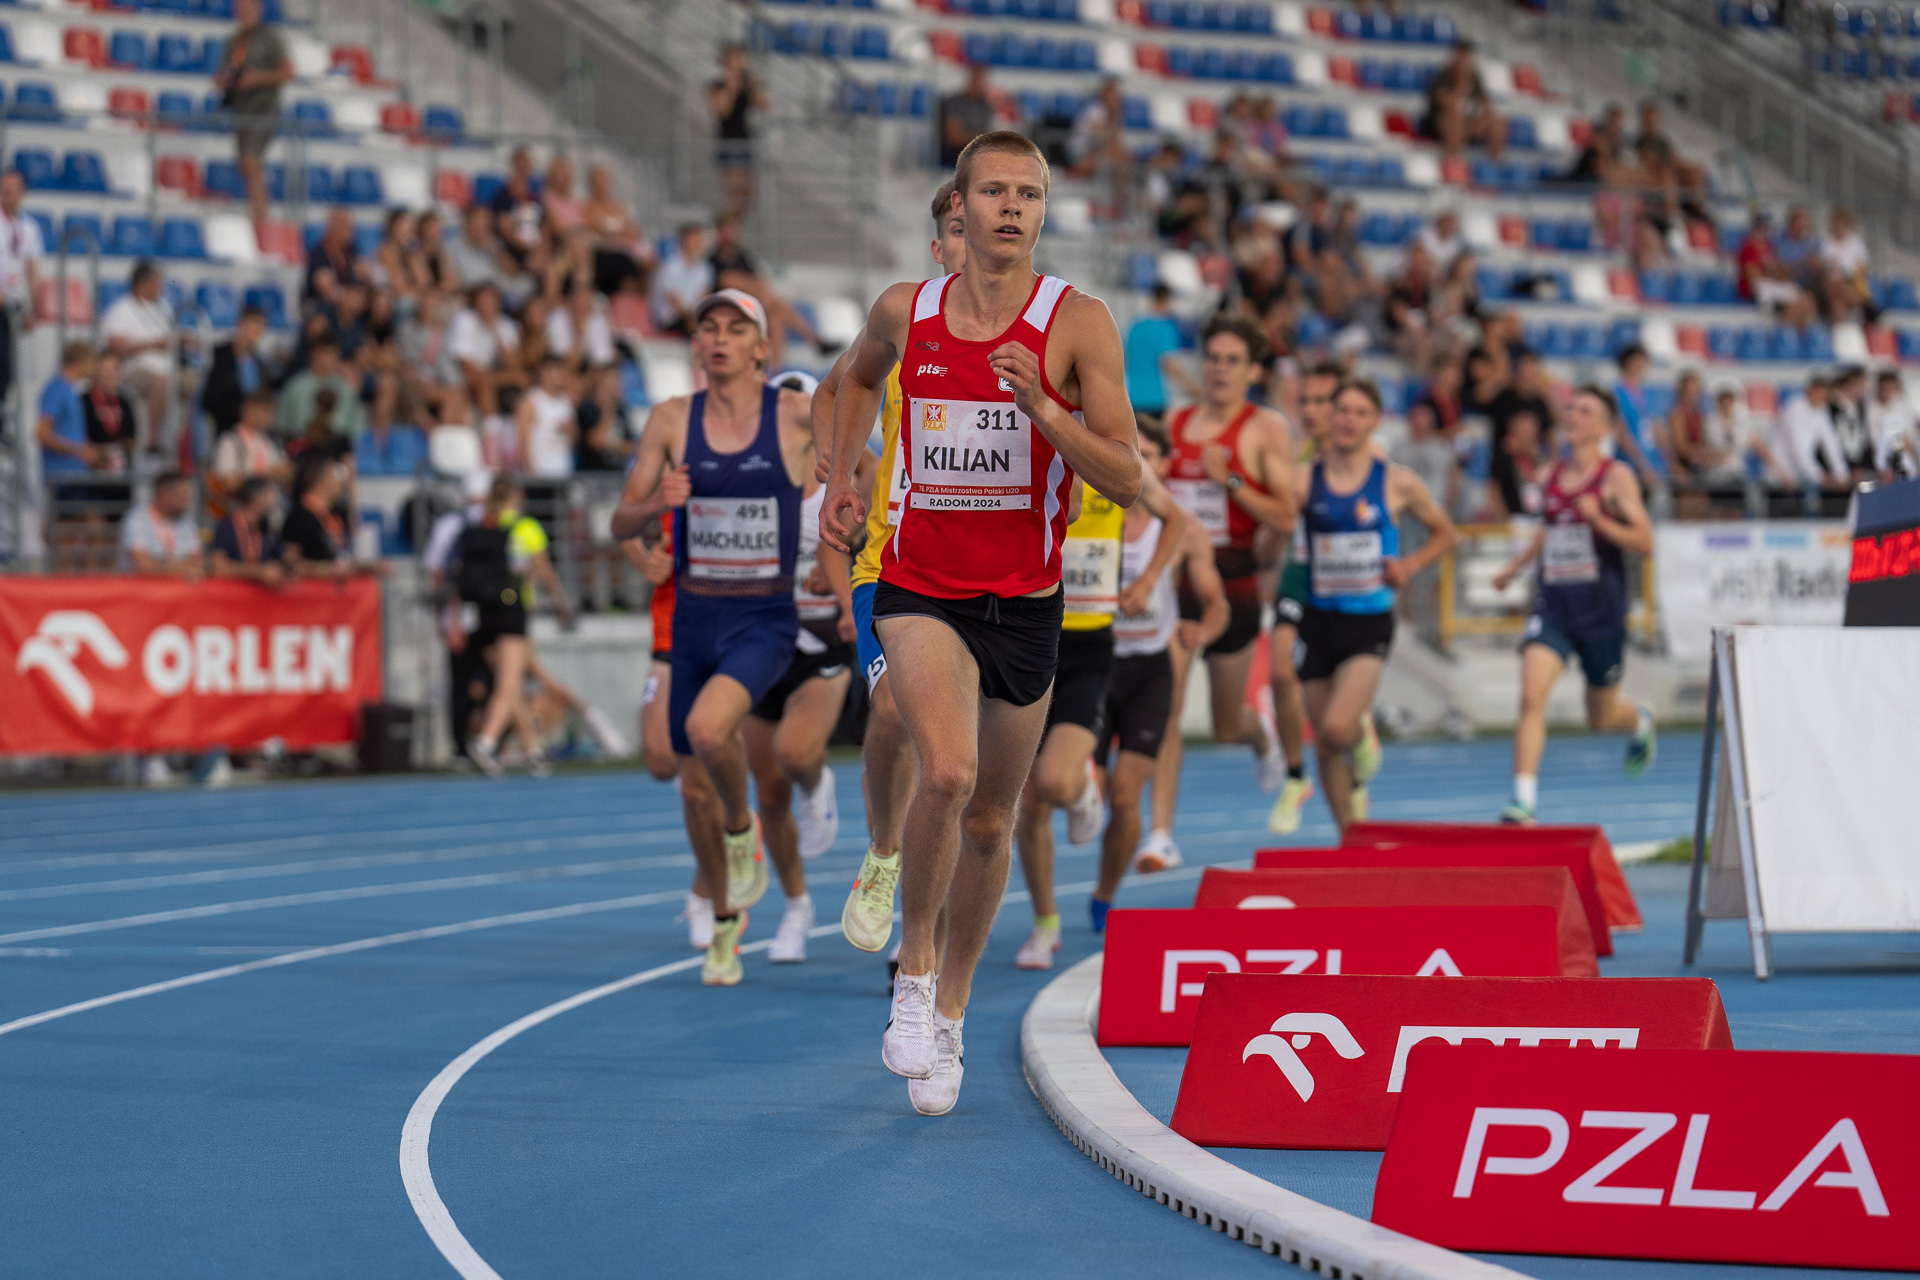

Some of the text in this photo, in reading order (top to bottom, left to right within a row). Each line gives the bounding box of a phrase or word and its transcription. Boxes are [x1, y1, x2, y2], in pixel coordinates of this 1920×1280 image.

[976, 408, 1019, 431] 311
[924, 445, 1010, 473] KILIAN
[940, 487, 982, 495] Mistrzostwa
[983, 487, 1005, 495] Polski
[736, 503, 769, 519] 491
[929, 498, 1002, 508] RADOM 2024
[691, 530, 777, 550] MACHULEC
[143, 624, 353, 695] ORLEN
[1453, 1096, 1891, 1217] PZLA
